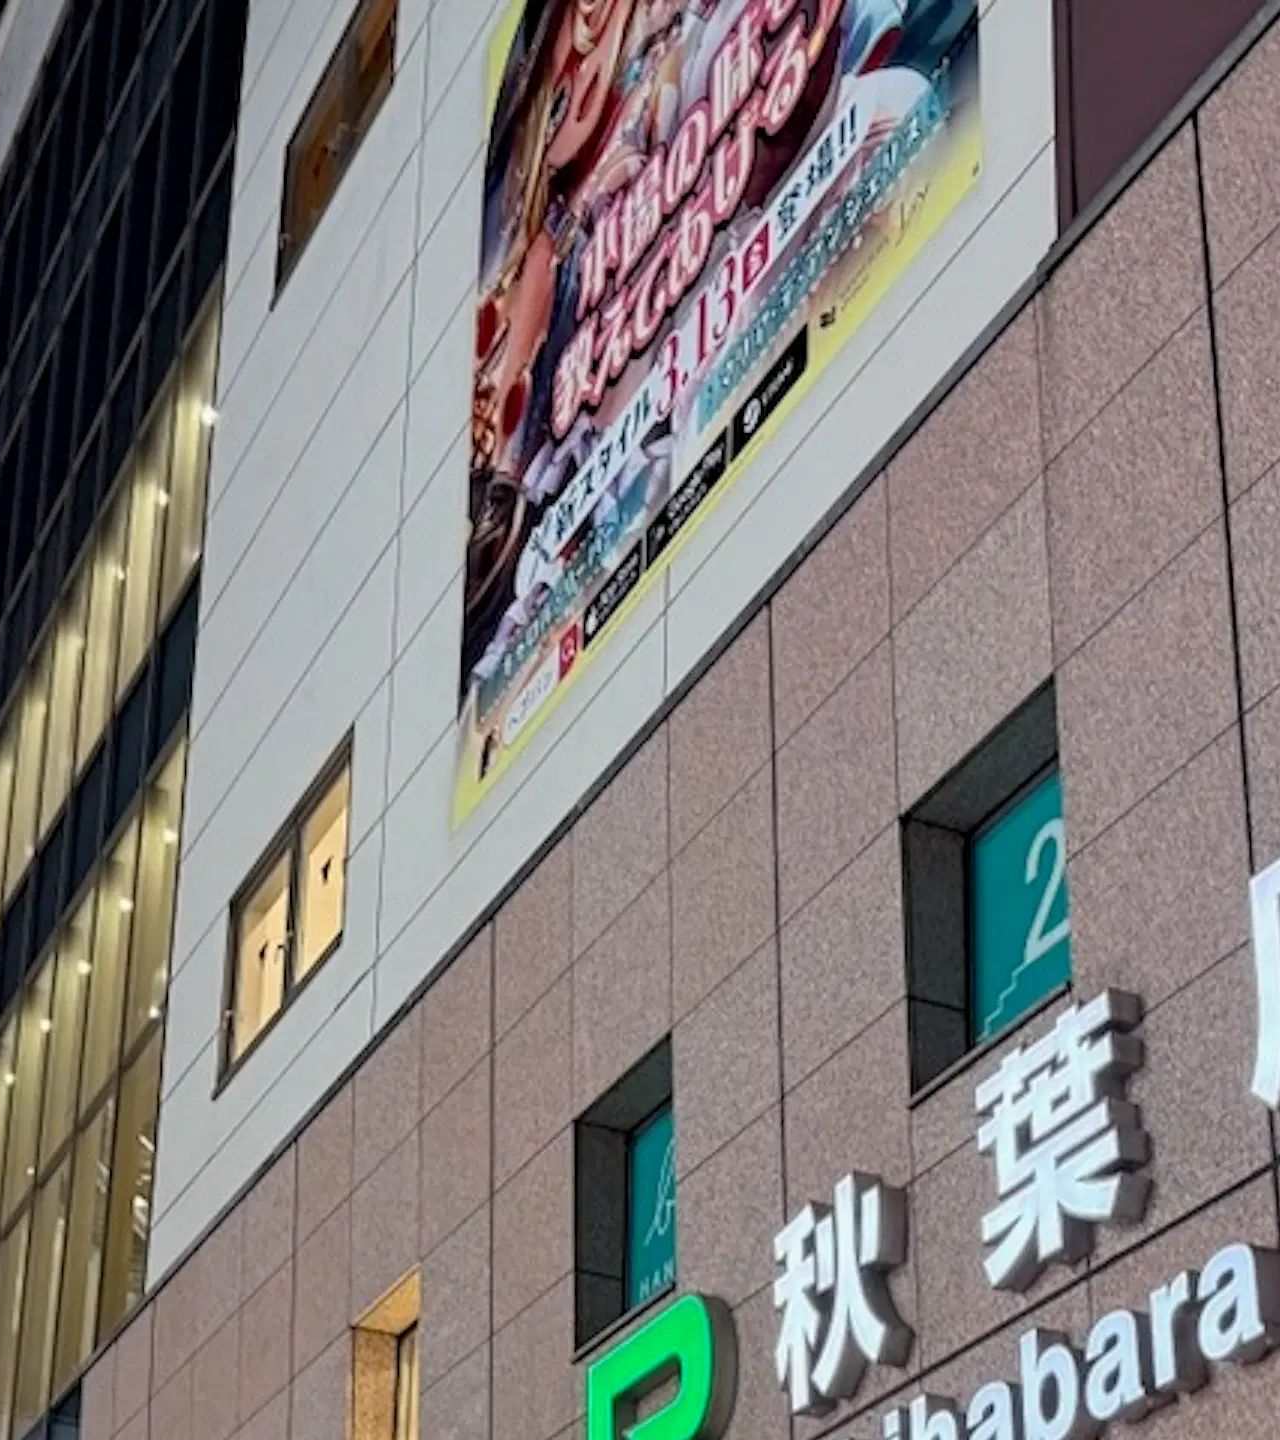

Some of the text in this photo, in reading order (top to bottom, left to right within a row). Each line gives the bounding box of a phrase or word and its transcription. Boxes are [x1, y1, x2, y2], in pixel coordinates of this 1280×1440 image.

[551, 10, 809, 440] 教えてあげる
